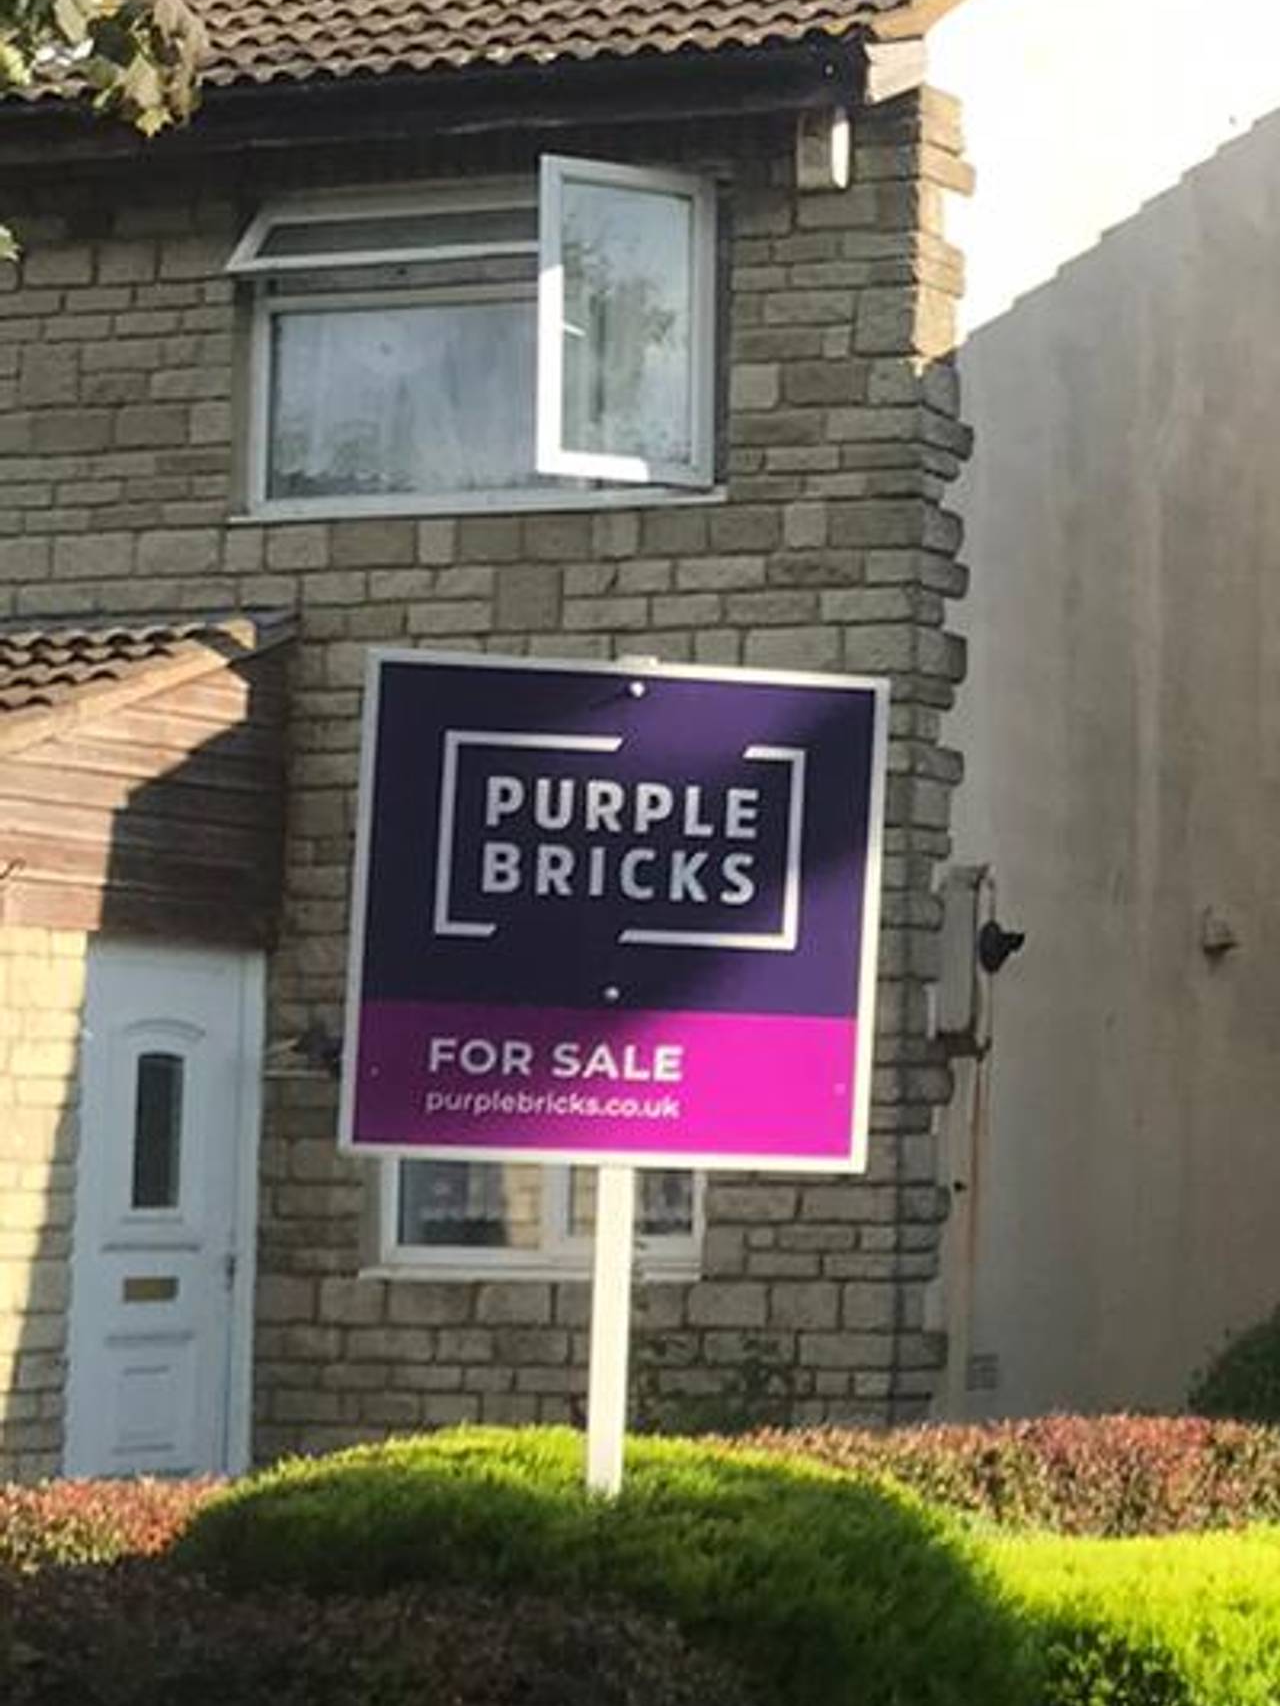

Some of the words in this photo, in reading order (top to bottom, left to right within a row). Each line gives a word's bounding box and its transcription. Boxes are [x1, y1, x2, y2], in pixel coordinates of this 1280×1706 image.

[485, 776, 759, 839] PURPLE
[481, 842, 757, 906] BRICKS
[428, 1038, 533, 1076] FOR
[552, 1044, 685, 1082] SALE
[425, 1091, 680, 1119] purplebricks.co.uk
